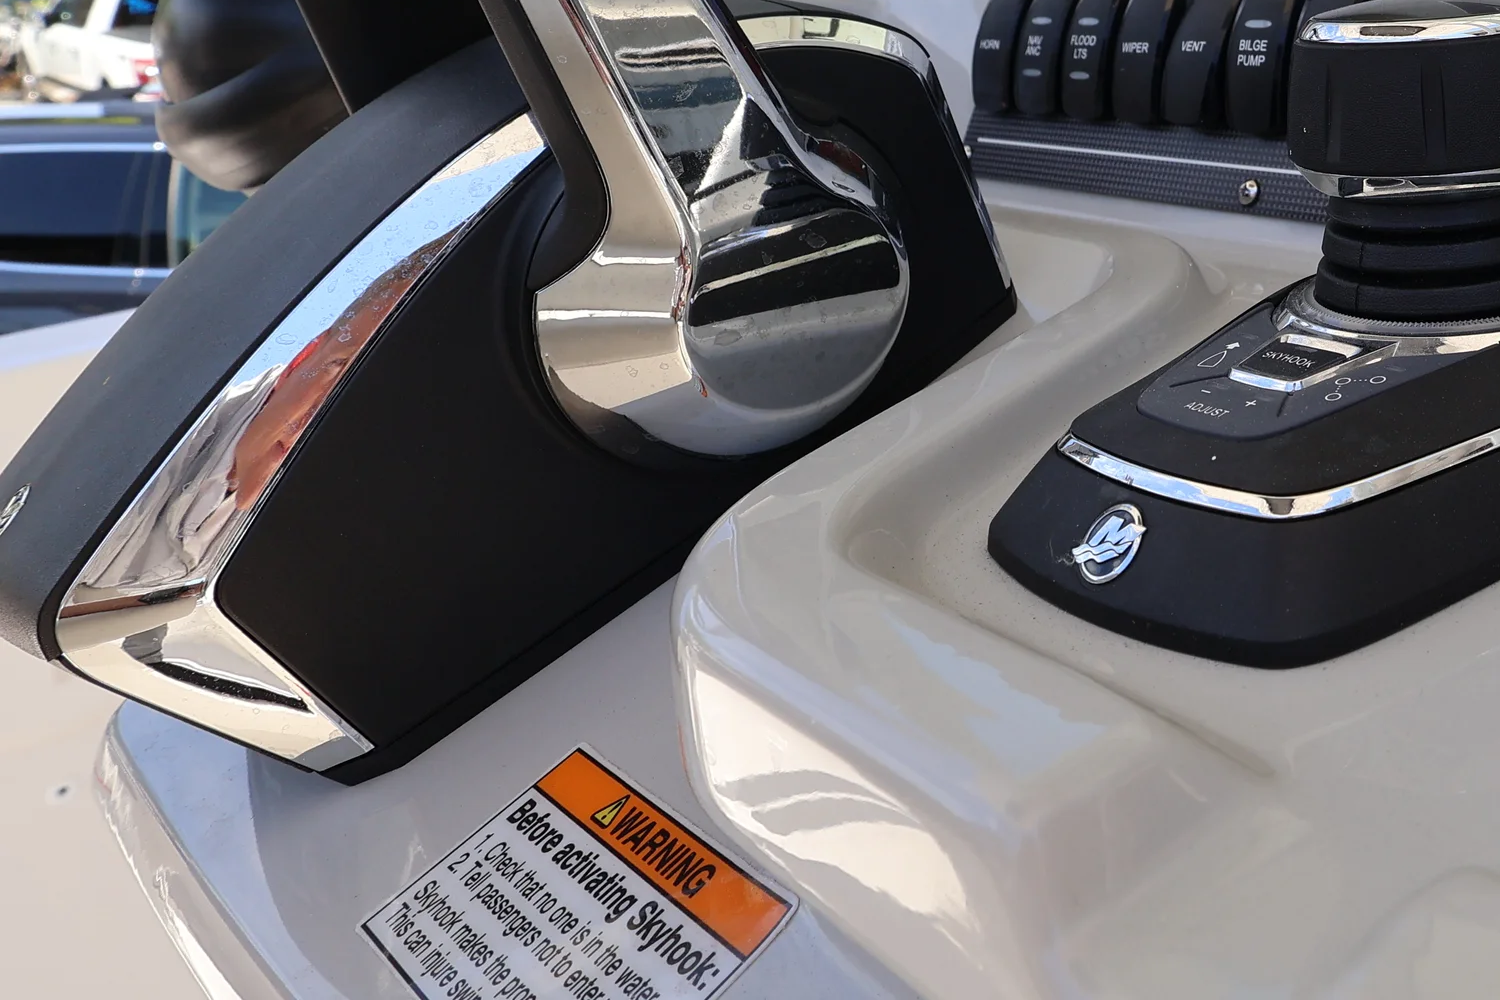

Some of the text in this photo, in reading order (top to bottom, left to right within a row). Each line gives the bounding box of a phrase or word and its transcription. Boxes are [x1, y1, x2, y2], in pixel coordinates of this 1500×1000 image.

[979, 39, 1000, 50] HORN
[1025, 46, 1041, 56] ANC
[1028, 35, 1043, 45] NAV
[1070, 35, 1097, 46] FLOOD
[1121, 42, 1149, 54] WIPER
[1181, 41, 1206, 52] VENT
[1239, 39, 1268, 52] BILGE
[1073, 48, 1088, 60] LTS
[1237, 54, 1266, 67] PUMP
[1262, 351, 1316, 368] SKYHOOK
[1184, 401, 1230, 418] ADJUST
[474, 833, 495, 854] 1.
[610, 806, 716, 899] WARNING
[447, 852, 471, 874] 2.
[484, 842, 527, 883] Check
[459, 861, 492, 892] Tell
[513, 870, 548, 902] that
[506, 798, 720, 991] Before activating Skyhook:
[533, 891, 558, 914] no
[469, 882, 542, 947] passengers
[548, 906, 580, 935] one
[385, 901, 417, 938] This
[403, 929, 432, 958] can
[420, 943, 458, 987] injure
[413, 880, 466, 934] Skyhook
[450, 923, 494, 968] makes
[483, 954, 511, 986] the
[569, 921, 592, 947] is
[580, 931, 604, 959] in
[531, 938, 565, 967] not
[593, 944, 623, 977] the
[550, 952, 573, 978] to
